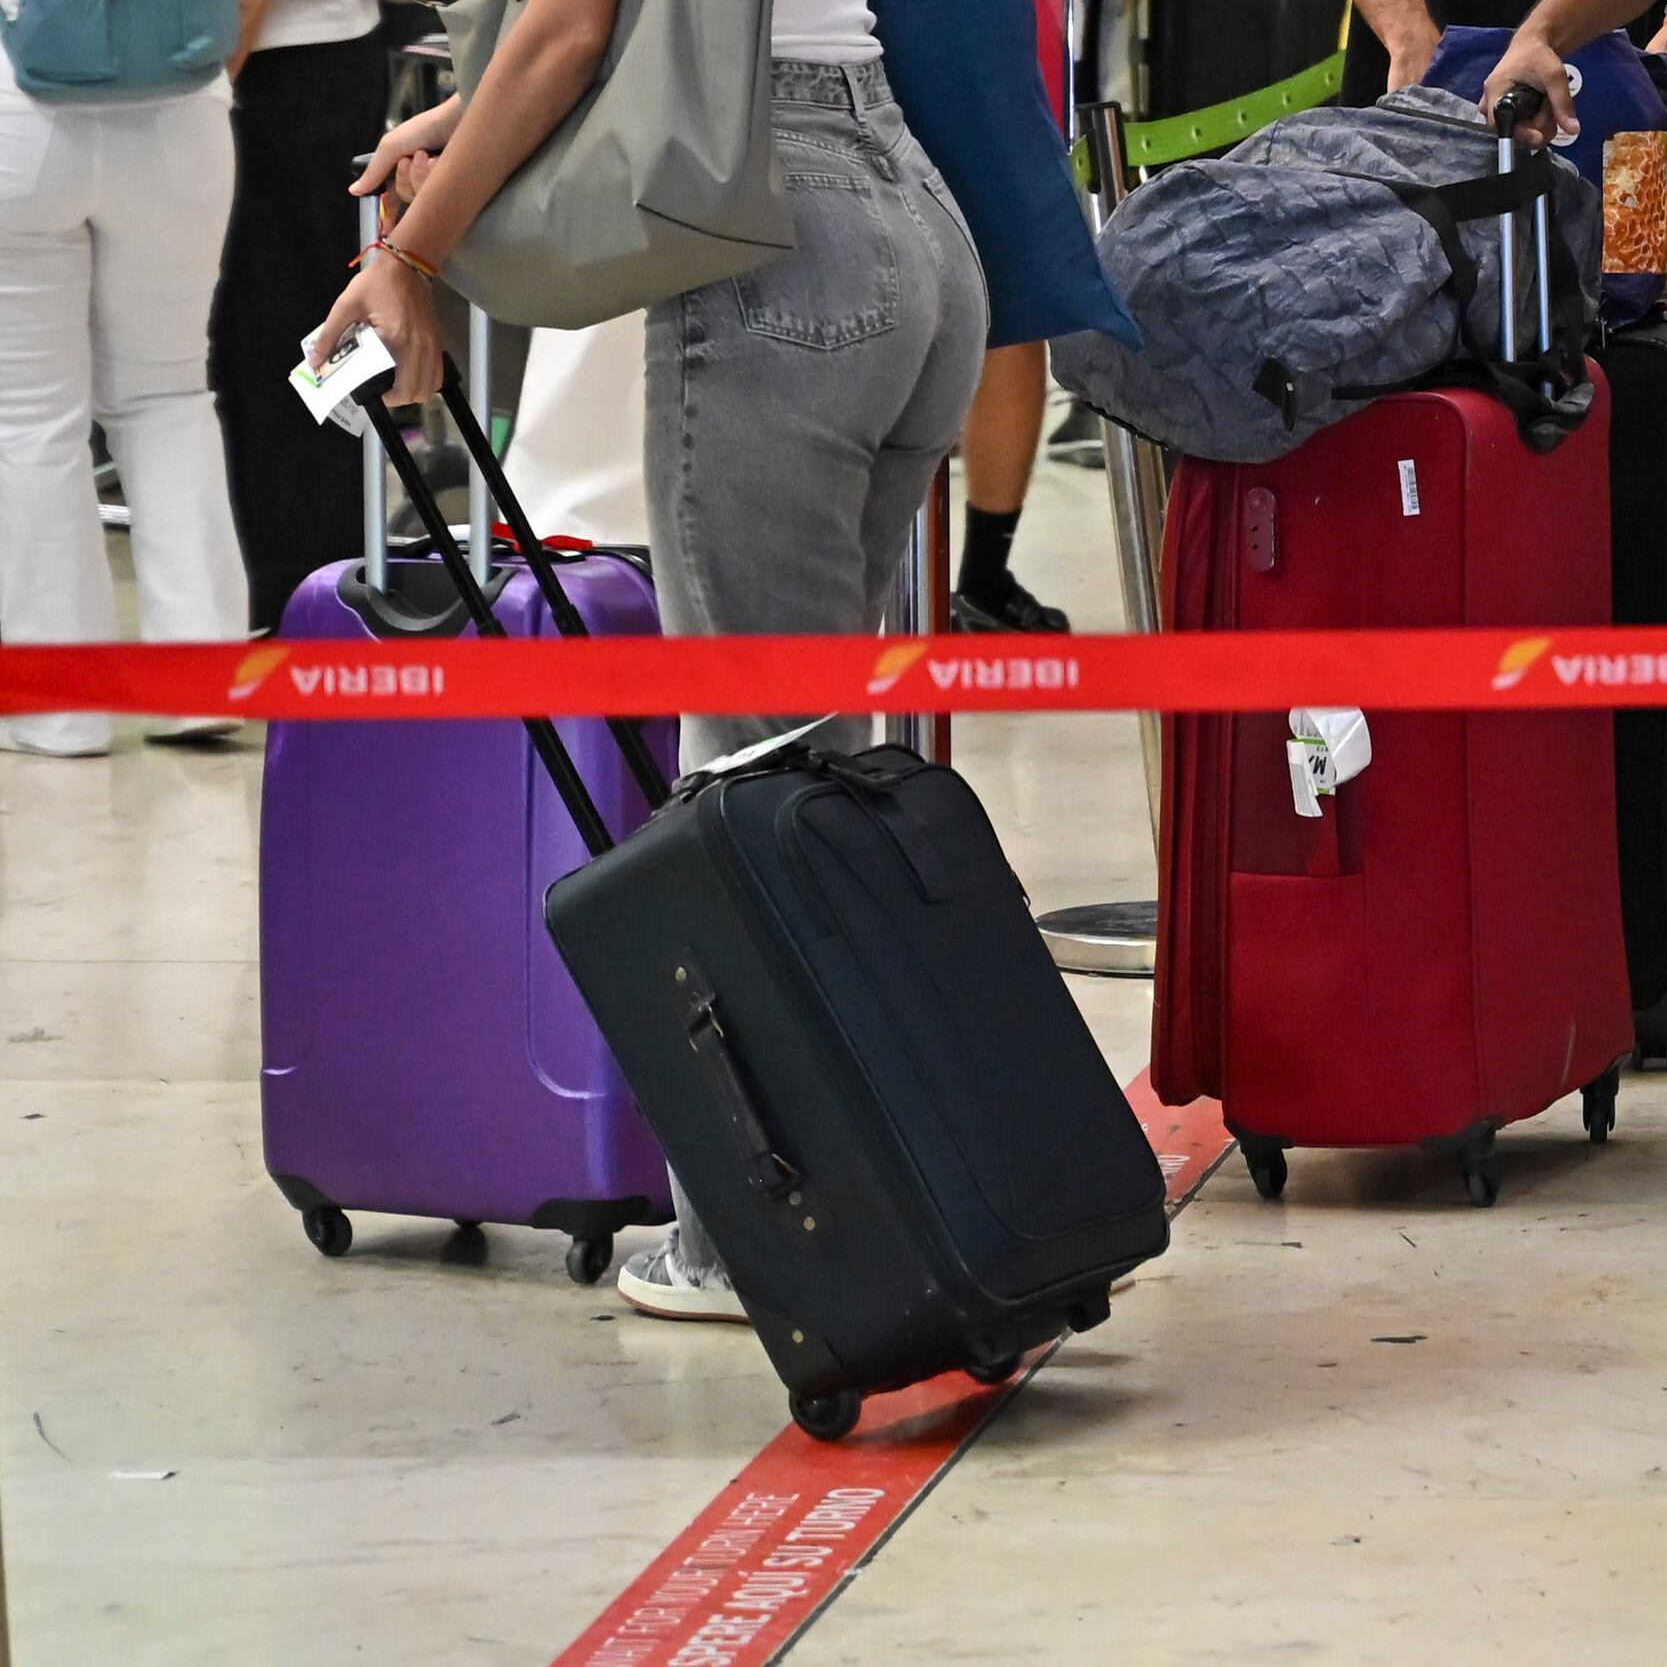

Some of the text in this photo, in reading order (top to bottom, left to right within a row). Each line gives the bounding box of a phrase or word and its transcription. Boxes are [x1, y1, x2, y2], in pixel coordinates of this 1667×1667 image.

[290, 665, 444, 696] IBERIA
[927, 658, 1079, 690] IBERIA
[721, 1493, 800, 1525] HERE
[683, 1529, 767, 1565] TURN
[644, 1566, 730, 1605] YOUR
[667, 1487, 885, 1667] SPERE AQUÍ SU TURNO
[617, 1607, 689, 1633] FOR
